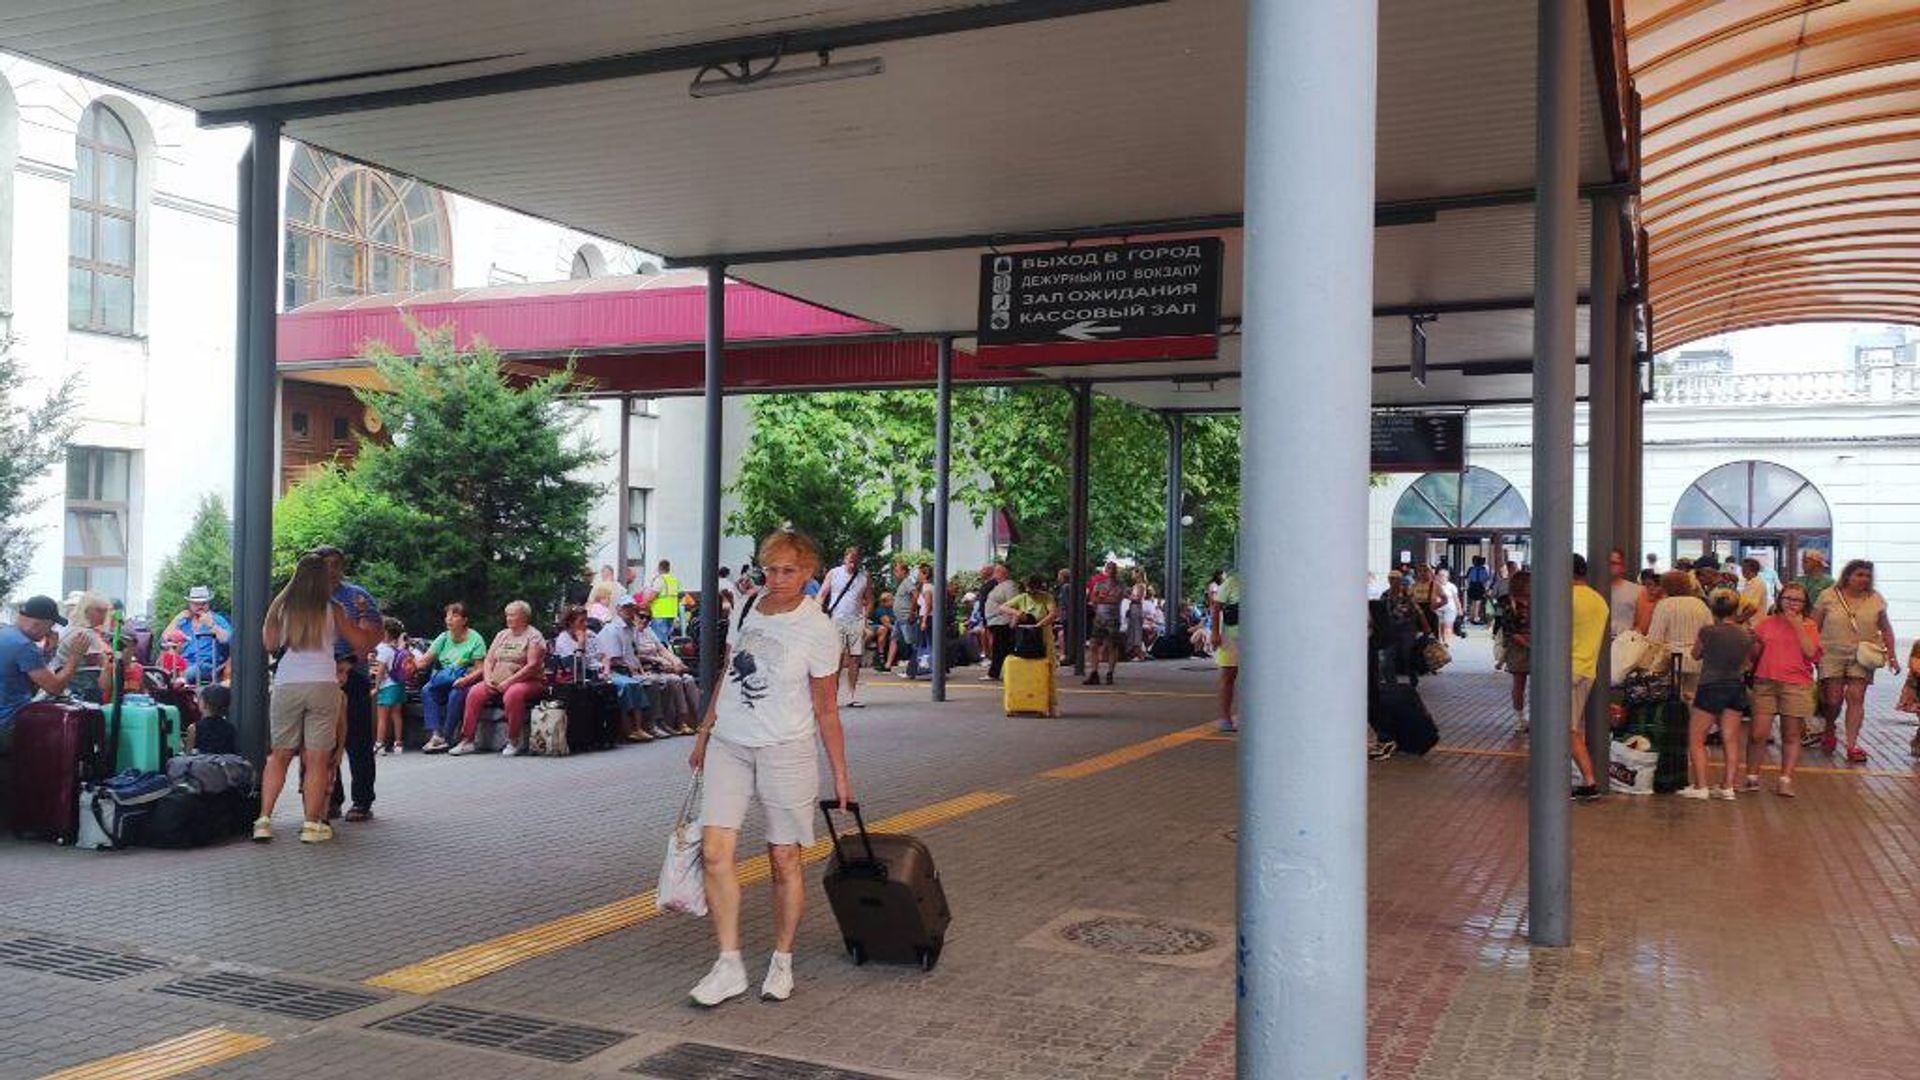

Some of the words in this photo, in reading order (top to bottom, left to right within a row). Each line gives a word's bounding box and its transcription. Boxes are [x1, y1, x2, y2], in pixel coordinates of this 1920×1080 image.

[1022, 253, 1098, 269] ВЫХОД
[1104, 251, 1118, 263] В
[1128, 245, 1201, 261] ГОРОД
[1022, 269, 1102, 288] ДЕЖУРНЫЙ
[1106, 270, 1127, 281] ПО
[1134, 264, 1201, 279] ВОКЗАЛУ
[1022, 292, 1063, 305] ЗАЛ
[1068, 283, 1198, 301] ОЖИДАНИЯ
[1020, 303, 1145, 323] КАССОВЫЙ
[1151, 303, 1196, 317] ЗАЛ
